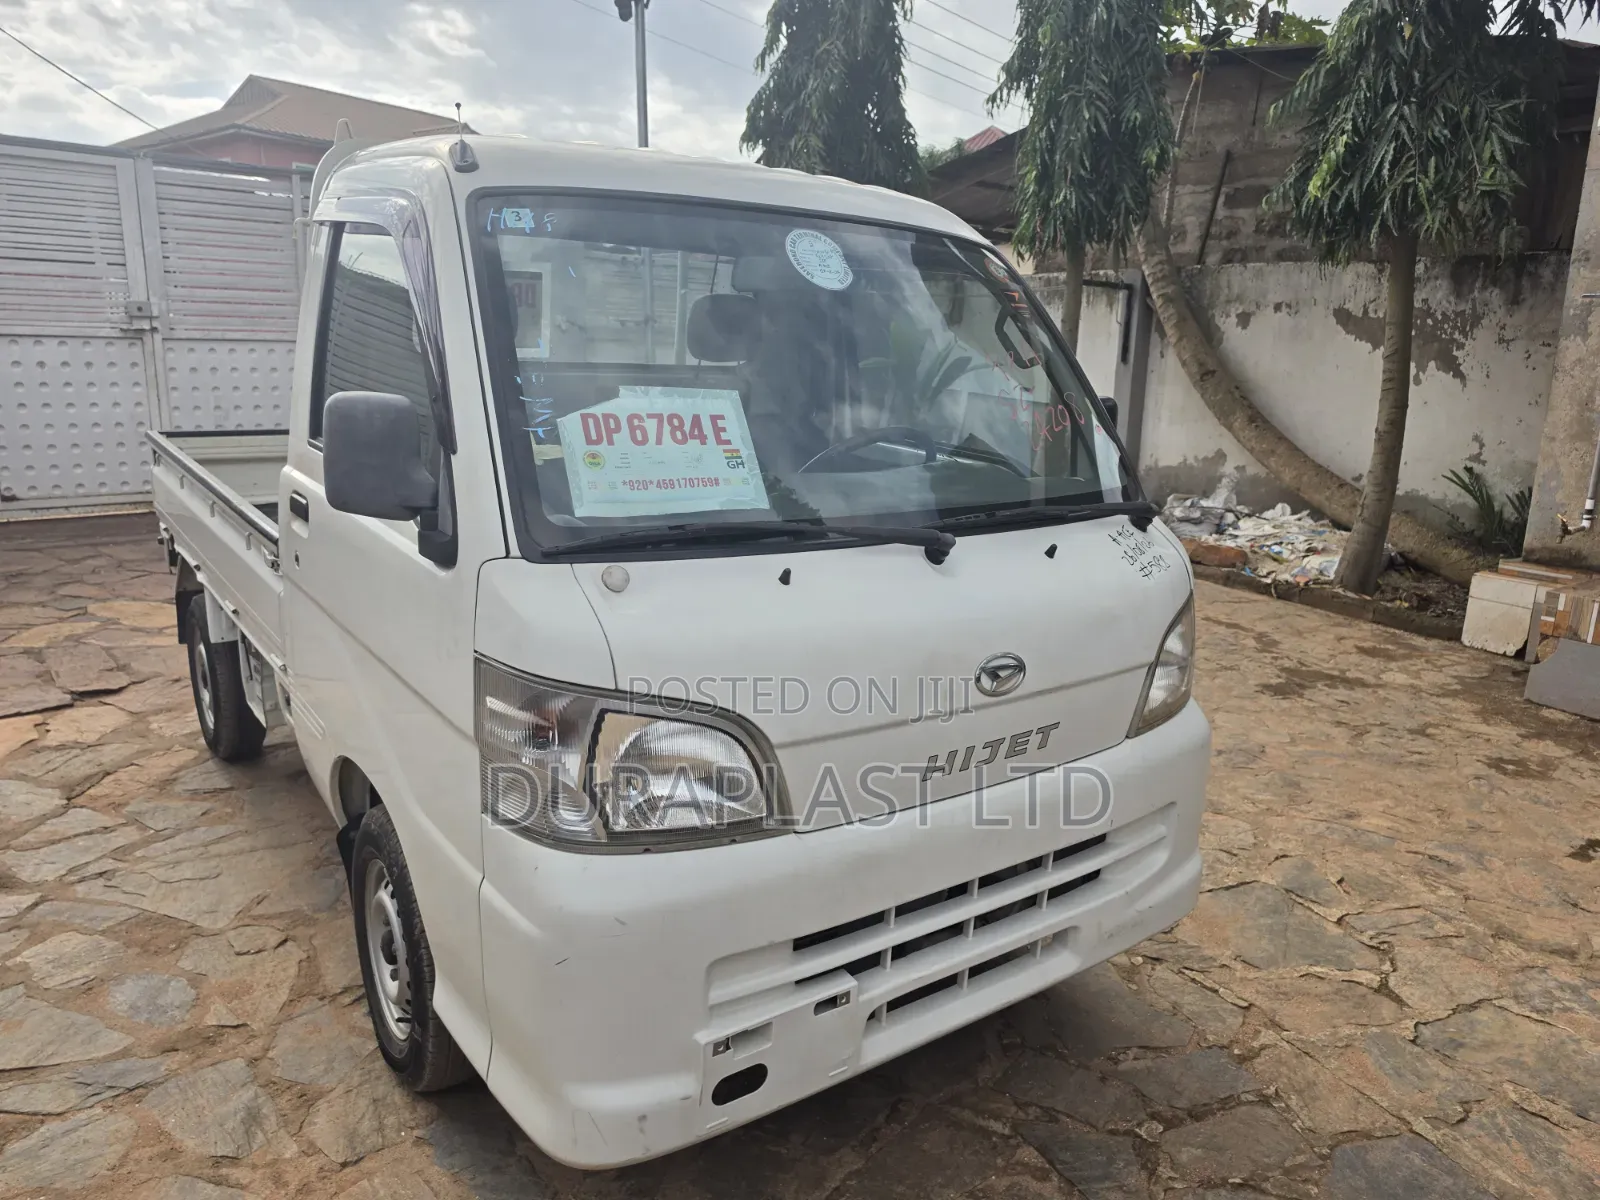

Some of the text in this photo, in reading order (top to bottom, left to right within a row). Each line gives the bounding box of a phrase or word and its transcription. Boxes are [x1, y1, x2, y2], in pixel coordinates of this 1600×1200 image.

[580, 412, 732, 446] DP 6784 E
[727, 460, 745, 469] GH
[922, 721, 1061, 782] HIJET
